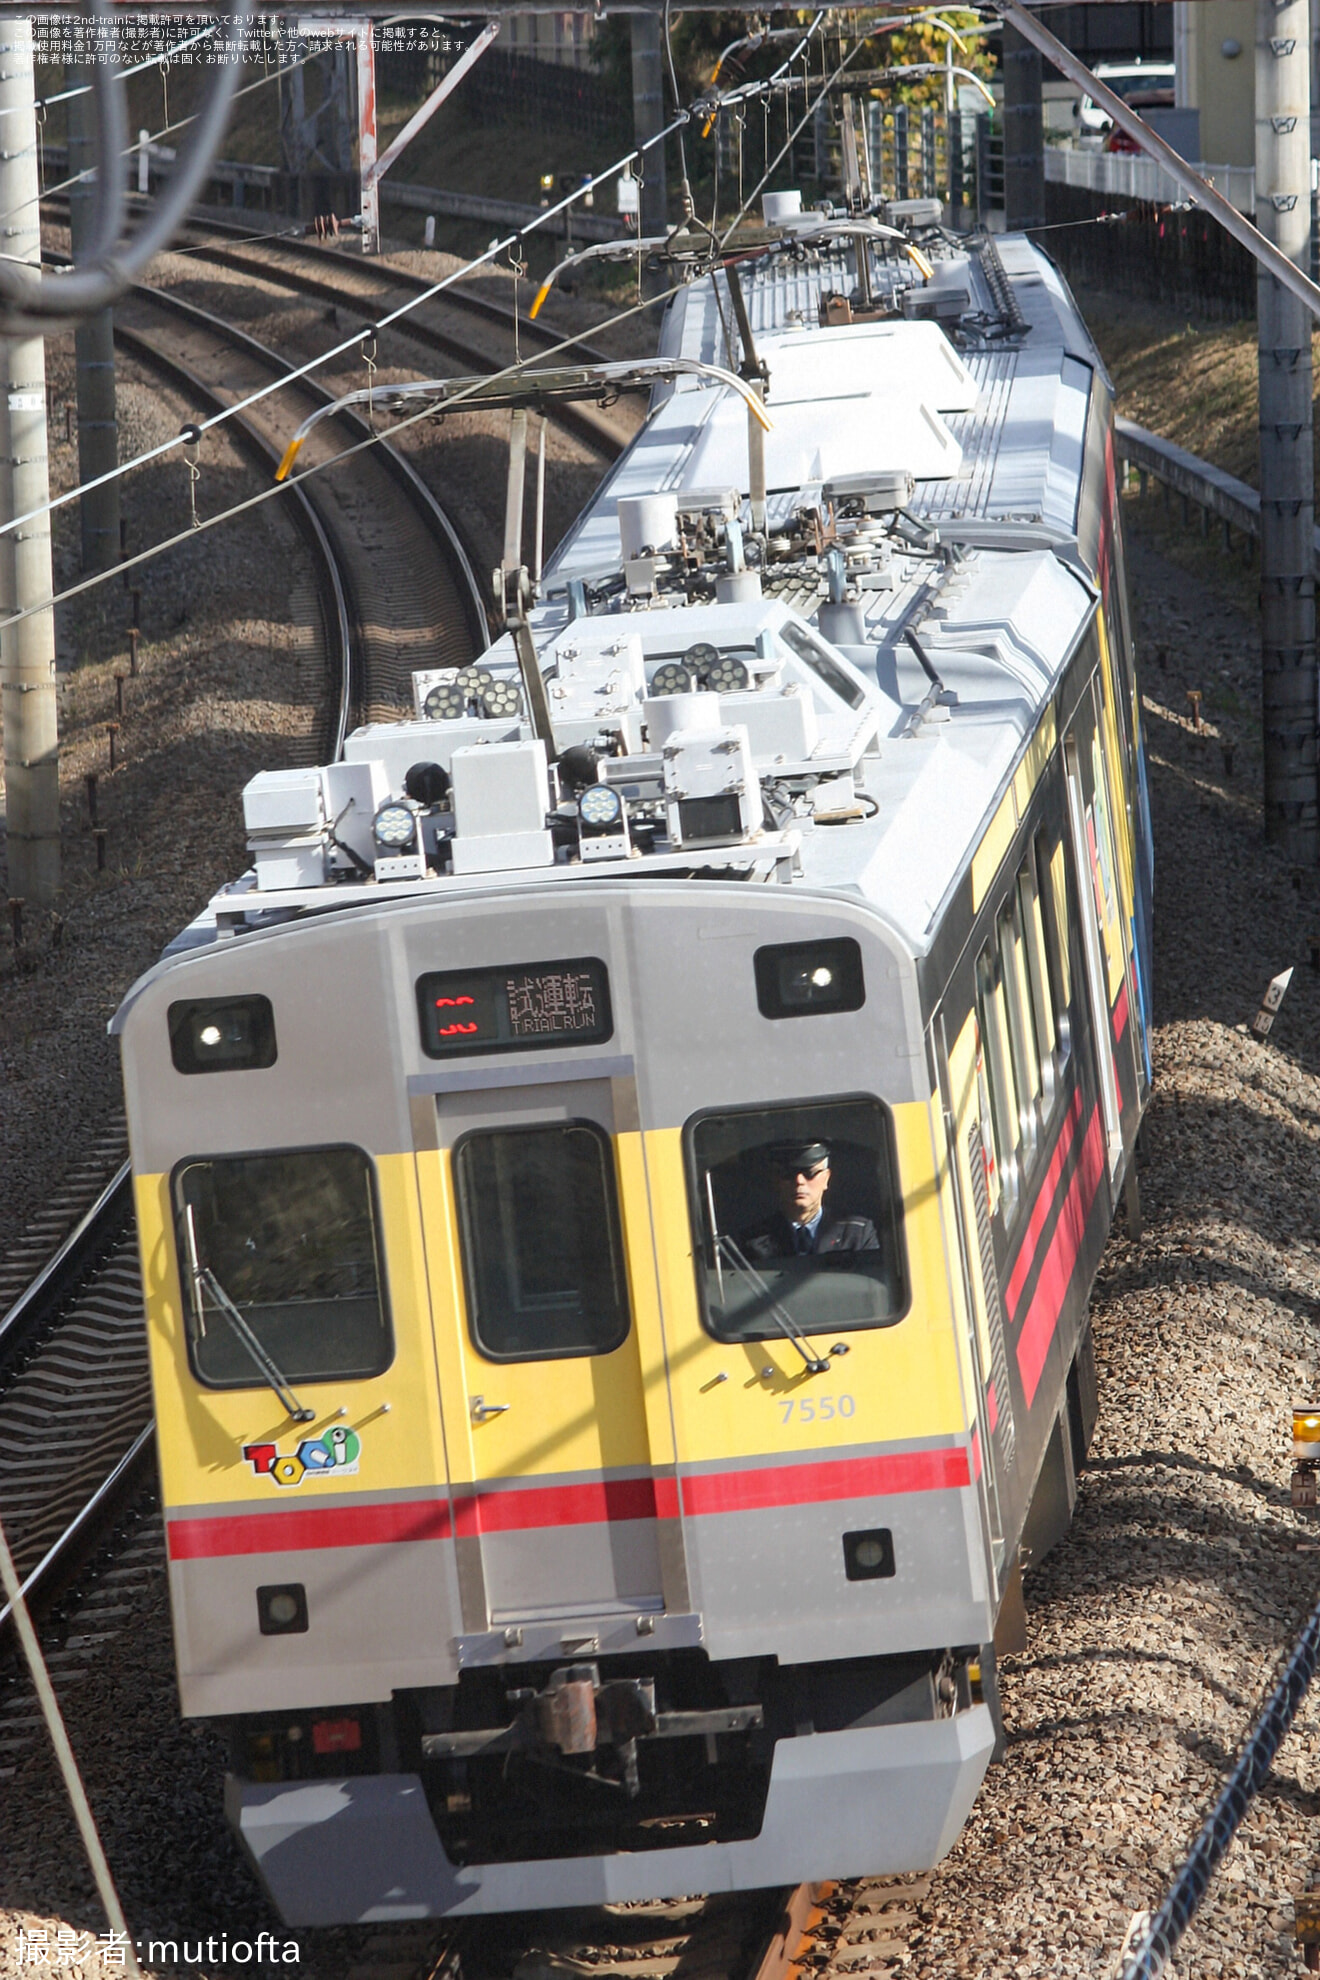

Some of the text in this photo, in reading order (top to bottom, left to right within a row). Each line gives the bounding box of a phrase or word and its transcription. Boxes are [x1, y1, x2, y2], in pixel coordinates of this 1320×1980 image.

[506, 973, 595, 1020] 試運転
[511, 1013, 596, 1035] TRIAL RUN
[777, 1394, 856, 1425] 7550
